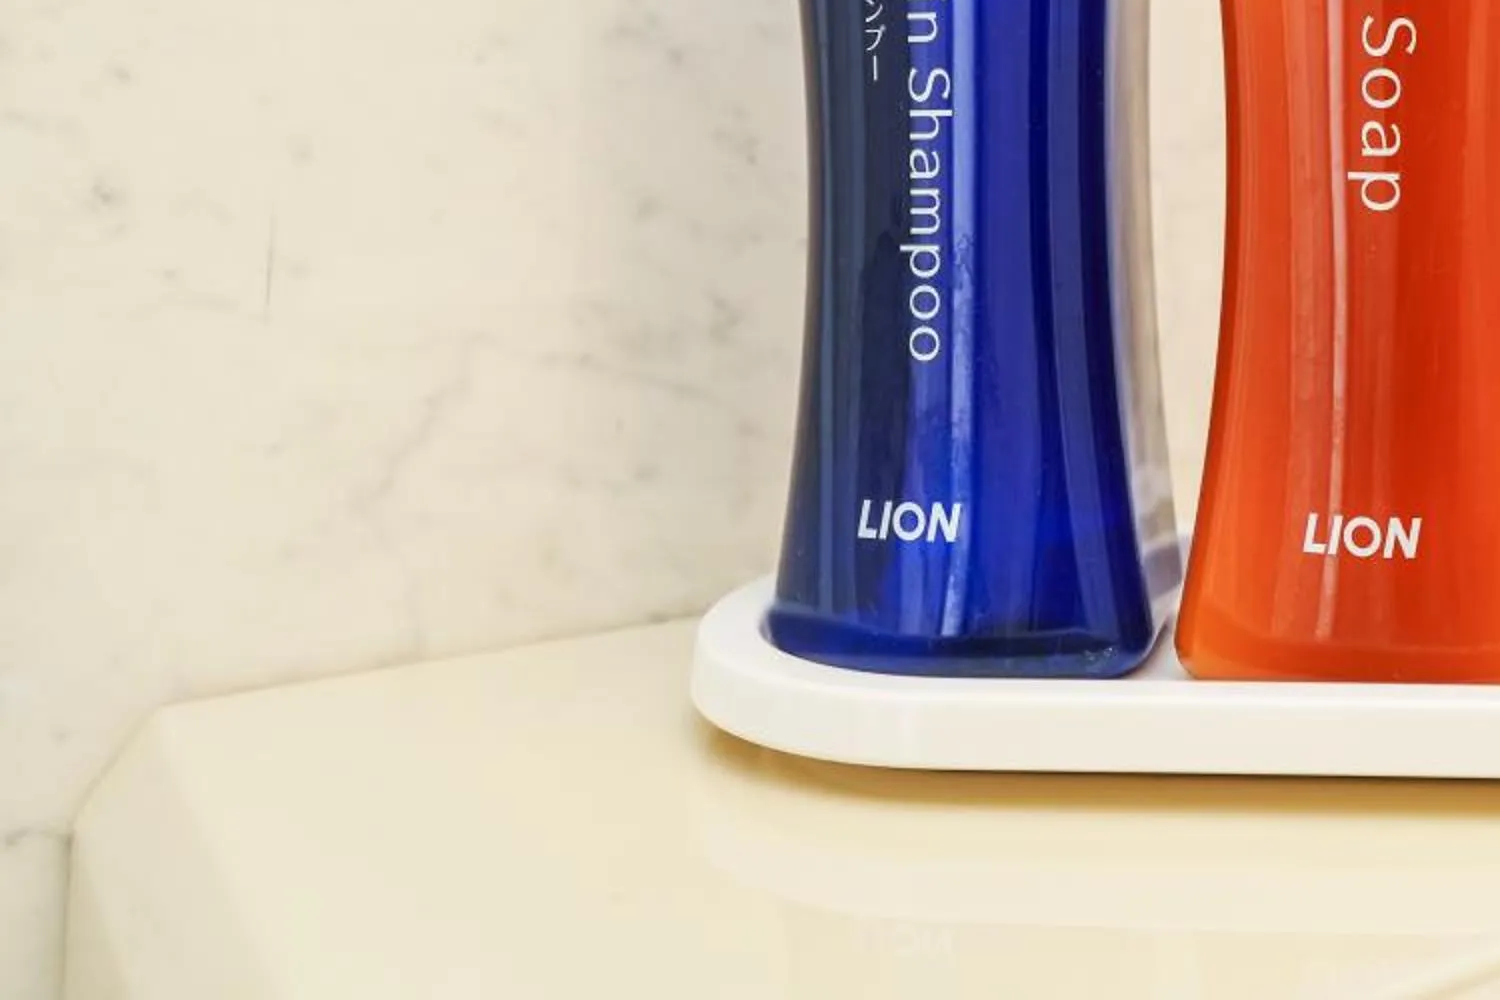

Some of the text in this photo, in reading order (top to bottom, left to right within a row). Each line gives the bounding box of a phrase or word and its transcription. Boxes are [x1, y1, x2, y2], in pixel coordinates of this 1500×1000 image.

[1347, 16, 1417, 213] Soap
[899, 67, 953, 362] Shampoo
[857, 500, 962, 543] LION
[1303, 513, 1421, 559] LION
